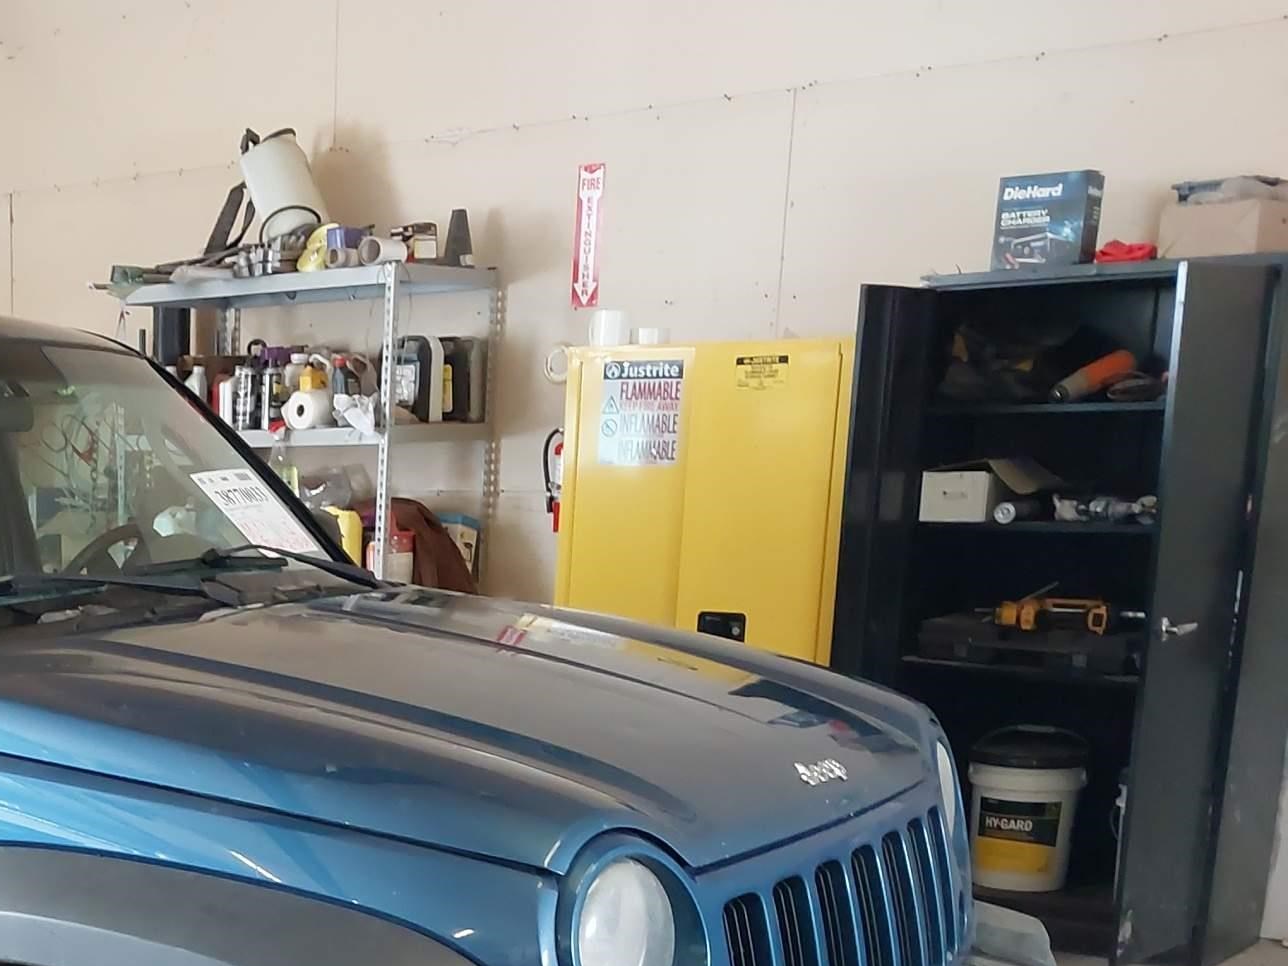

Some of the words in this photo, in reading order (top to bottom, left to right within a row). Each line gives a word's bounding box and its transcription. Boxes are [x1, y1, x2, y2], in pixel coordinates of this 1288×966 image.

[582, 177, 601, 191] FIRE
[1003, 183, 1064, 201] DieHard
[1001, 208, 1049, 219] BATTERY
[580, 196, 593, 297] EXTINGUISHER
[621, 361, 680, 378] Justrite
[619, 380, 682, 401] FLAMMABLE
